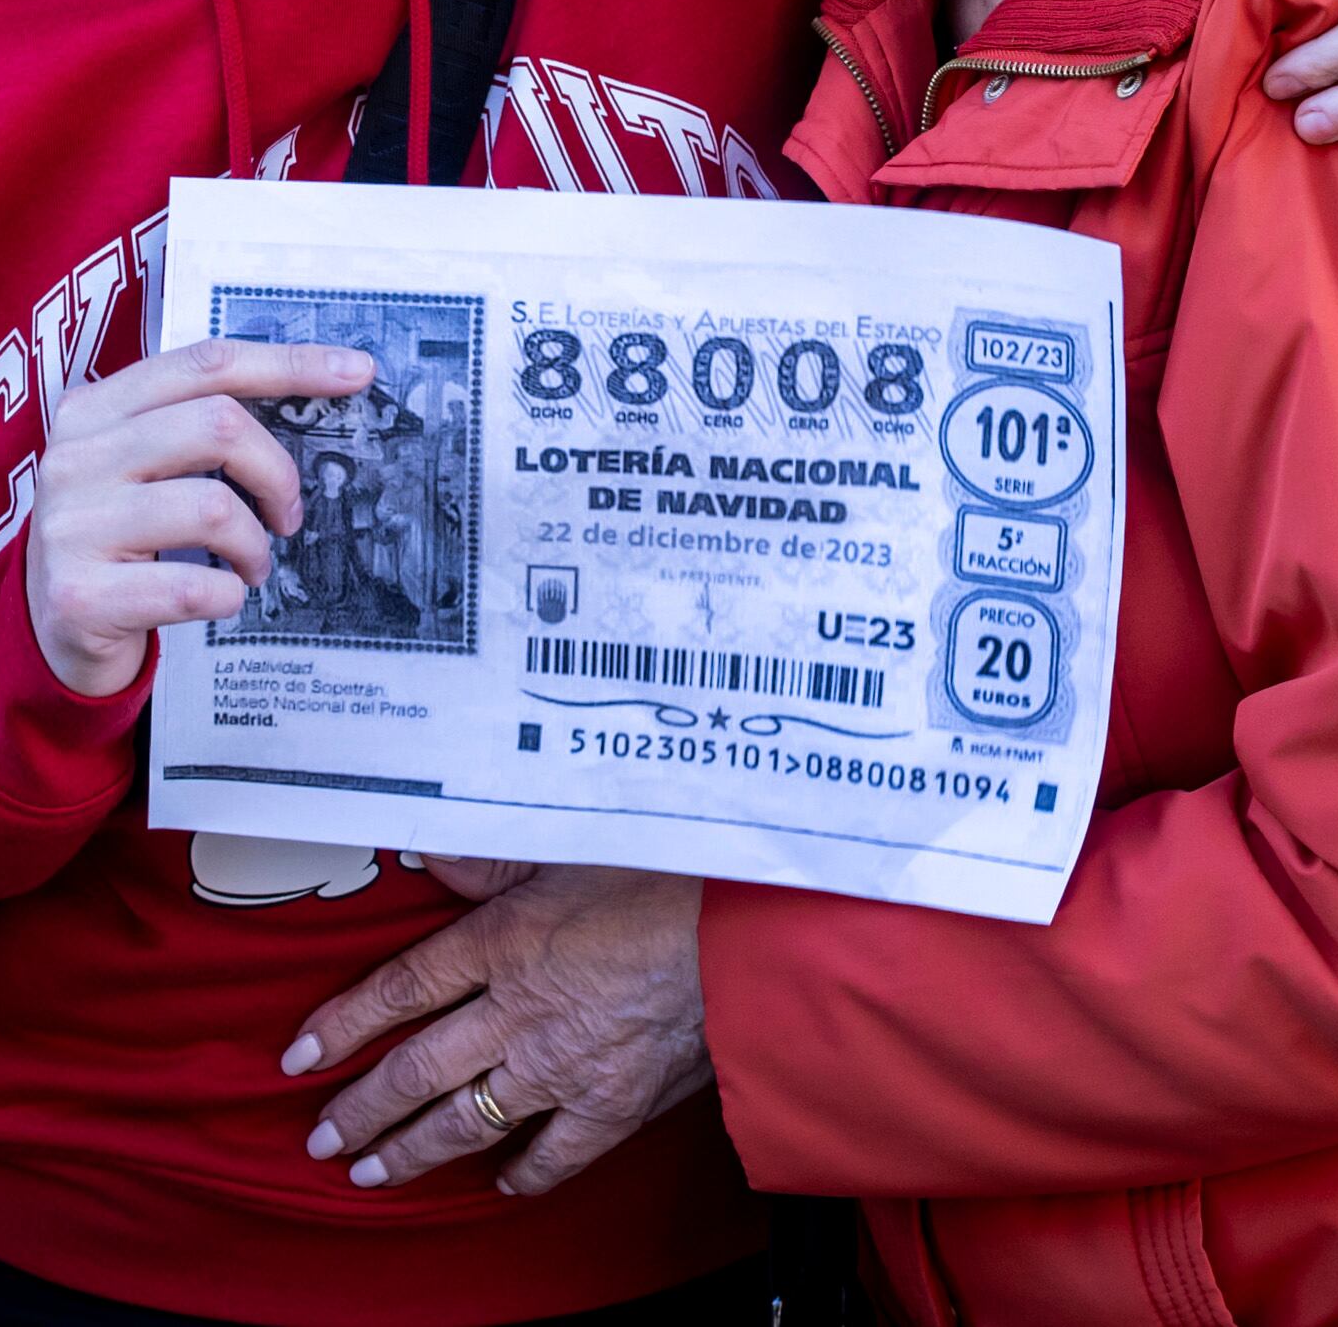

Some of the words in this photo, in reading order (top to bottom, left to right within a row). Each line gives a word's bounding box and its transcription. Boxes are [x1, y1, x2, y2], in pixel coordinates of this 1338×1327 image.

[695, 310, 806, 336] APUESTAS
[816, 321, 848, 338] DEL
[857, 315, 942, 344] ESTADO
[981, 337, 1063, 369] 102/23
[520, 328, 925, 415] 88008
[530, 406, 573, 420] OCHO
[615, 410, 659, 424] OCHO
[704, 415, 743, 429] CERO
[788, 417, 829, 431] CERO
[873, 420, 915, 435] OCHO
[515, 446, 695, 478] LOTERÍA
[709, 455, 921, 491] NACIONAL
[994, 476, 1035, 496] SERIE
[588, 486, 643, 512] DE
[657, 490, 848, 524] NAVIDAD
[537, 522, 573, 543] 22
[583, 523, 617, 546] de
[628, 525, 771, 555] diciembre
[781, 533, 816, 559] de
[825, 539, 893, 567] 2023
[968, 551, 1051, 578] FRACCIÓN
[979, 606, 1036, 629] PRECIO
[215, 660, 234, 674] La
[975, 635, 1032, 683] 20
[214, 678, 280, 692] Maestro
[285, 680, 306, 693] de
[973, 689, 1032, 708] EUROS
[214, 695, 269, 709] Museo
[274, 697, 345, 713] Nacional
[350, 702, 374, 715] del
[213, 713, 278, 727] Madrid.
